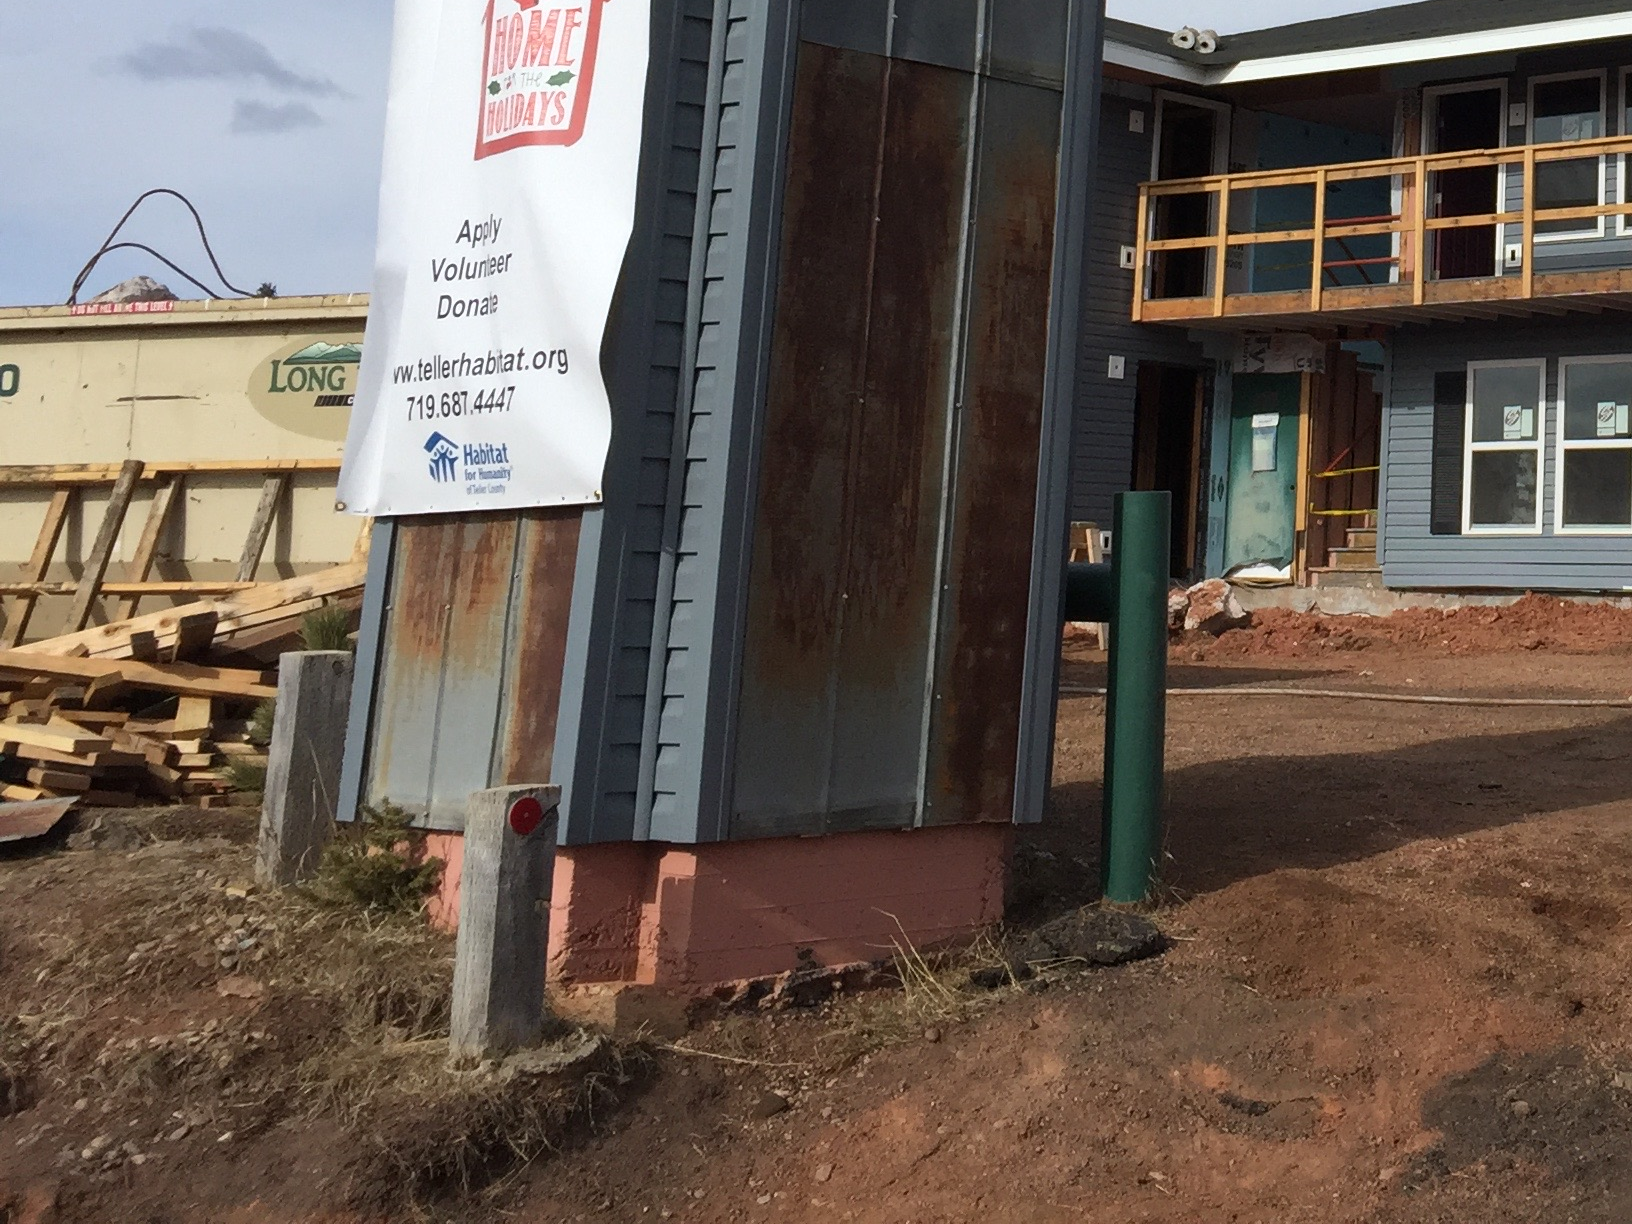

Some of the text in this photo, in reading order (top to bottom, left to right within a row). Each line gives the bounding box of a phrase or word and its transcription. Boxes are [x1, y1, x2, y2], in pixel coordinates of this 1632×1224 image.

[492, 7, 582, 76] HOME
[486, 91, 567, 136] HOLIDAYS
[455, 214, 502, 248] Apply
[432, 253, 512, 282] Volunteer
[437, 292, 498, 319] Donate
[268, 359, 347, 393] LONG
[407, 386, 515, 421] 719.687.4447
[463, 443, 509, 466] Habitat
[465, 468, 476, 481] for
